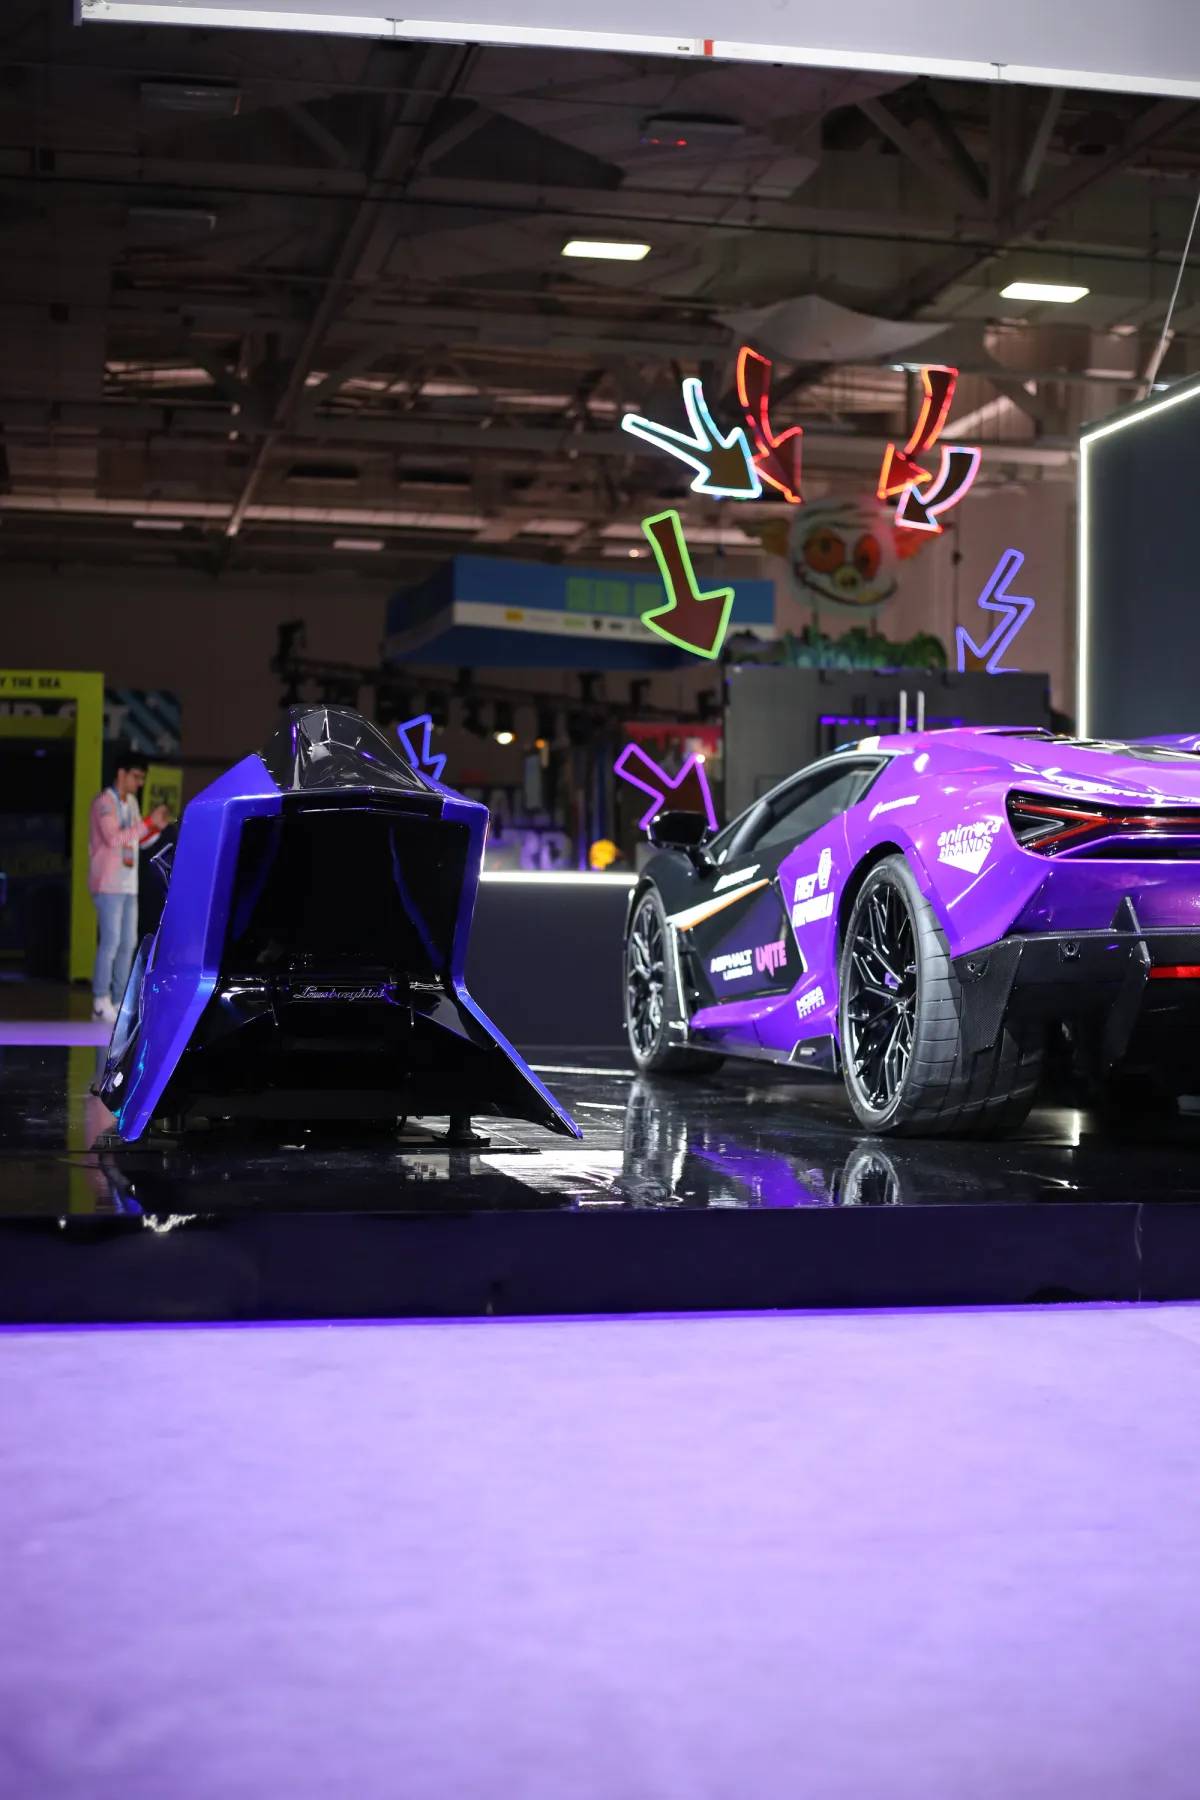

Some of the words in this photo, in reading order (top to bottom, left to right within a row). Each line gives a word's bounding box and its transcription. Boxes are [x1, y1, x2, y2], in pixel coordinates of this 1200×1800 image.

[12, 676, 32, 688] THE
[38, 677, 61, 689] SEA
[937, 820, 1002, 846] animoca
[939, 835, 993, 859] BRANDS
[755, 940, 787, 976] UNITE
